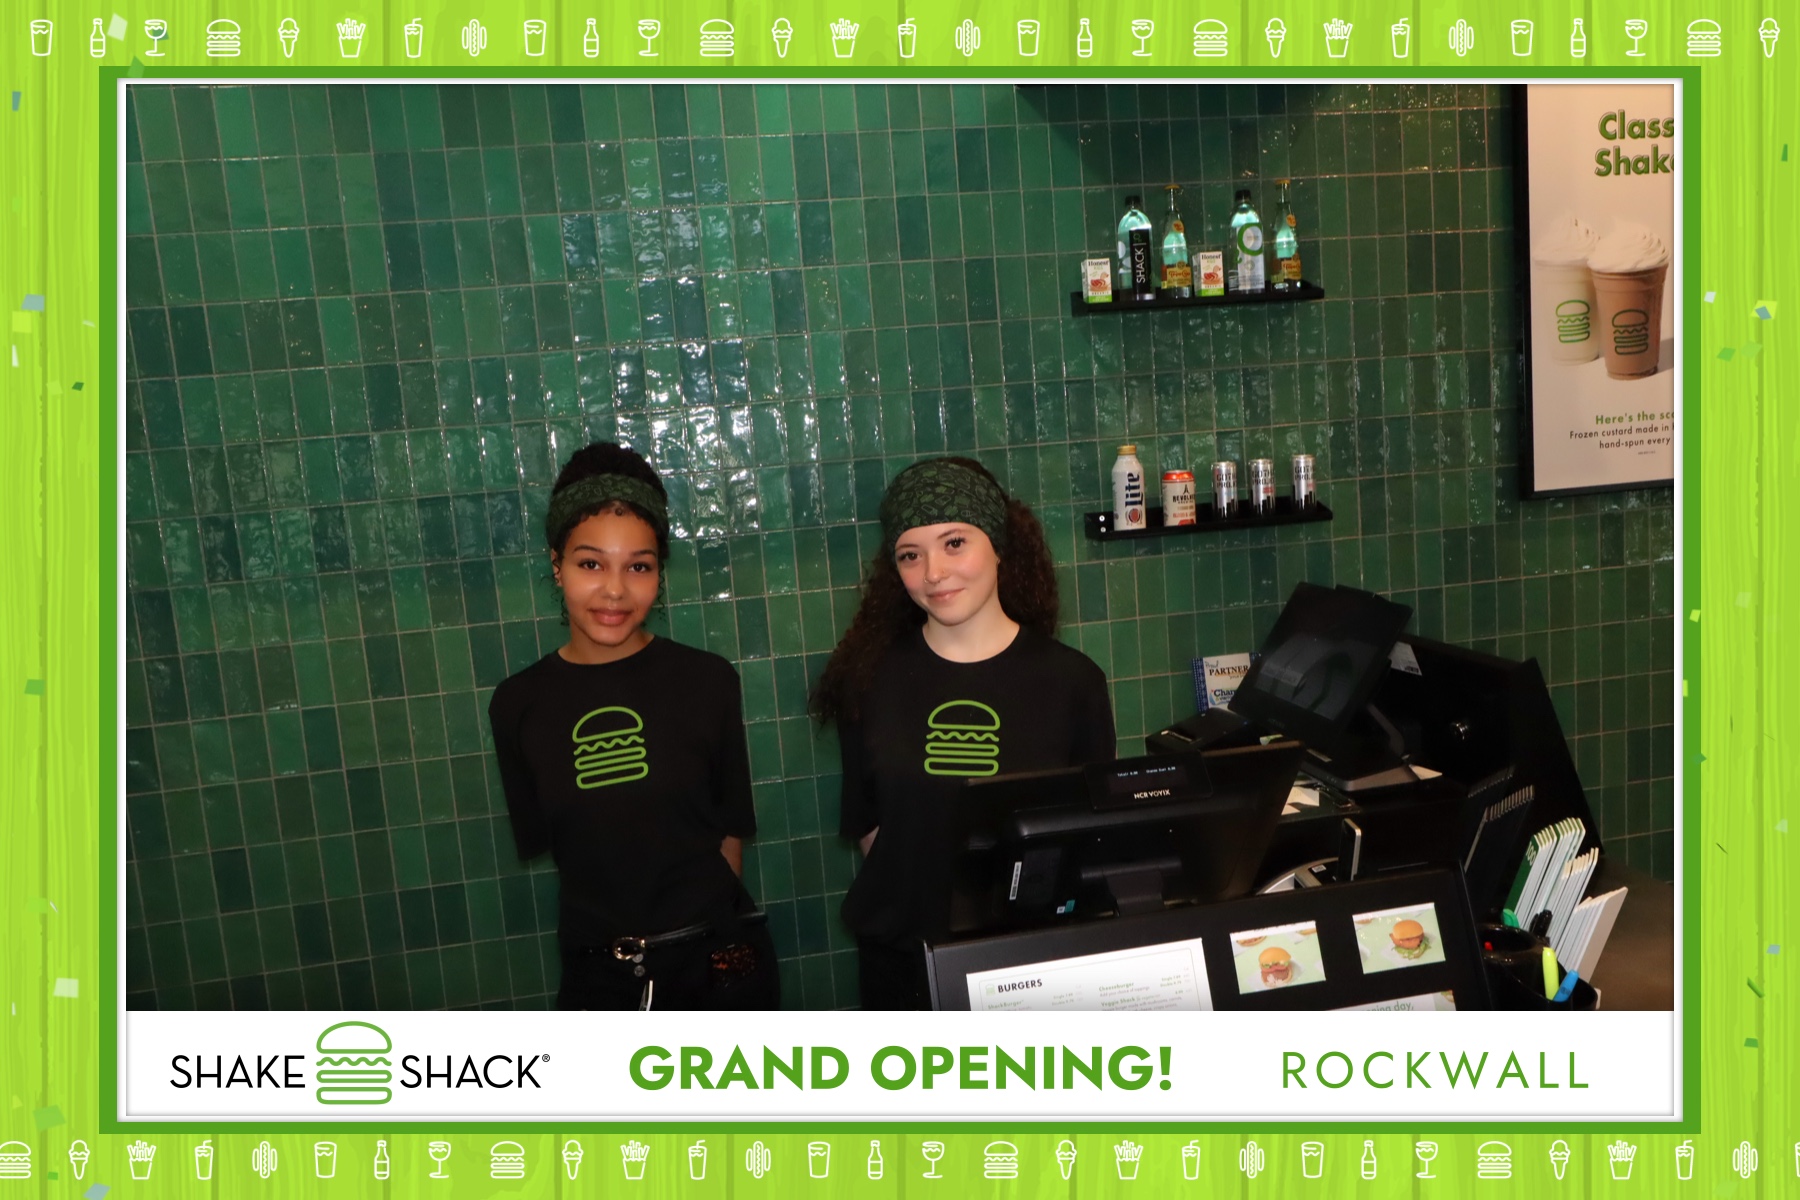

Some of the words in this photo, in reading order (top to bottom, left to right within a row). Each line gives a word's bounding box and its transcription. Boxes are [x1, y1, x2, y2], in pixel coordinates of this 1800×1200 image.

[1135, 247, 1146, 283] SHACK
[1596, 412, 1633, 425] Here's
[1637, 410, 1656, 421] the
[1570, 430, 1599, 439] Frozen
[1601, 425, 1633, 437] custard
[1635, 423, 1659, 434] made
[1661, 423, 1669, 432] in
[1600, 438, 1644, 449] hand-spun
[1647, 437, 1671, 445] every
[1125, 472, 1144, 508] Lite
[1149, 789, 1171, 798] VOYIX
[998, 979, 1043, 993] BURGERS
